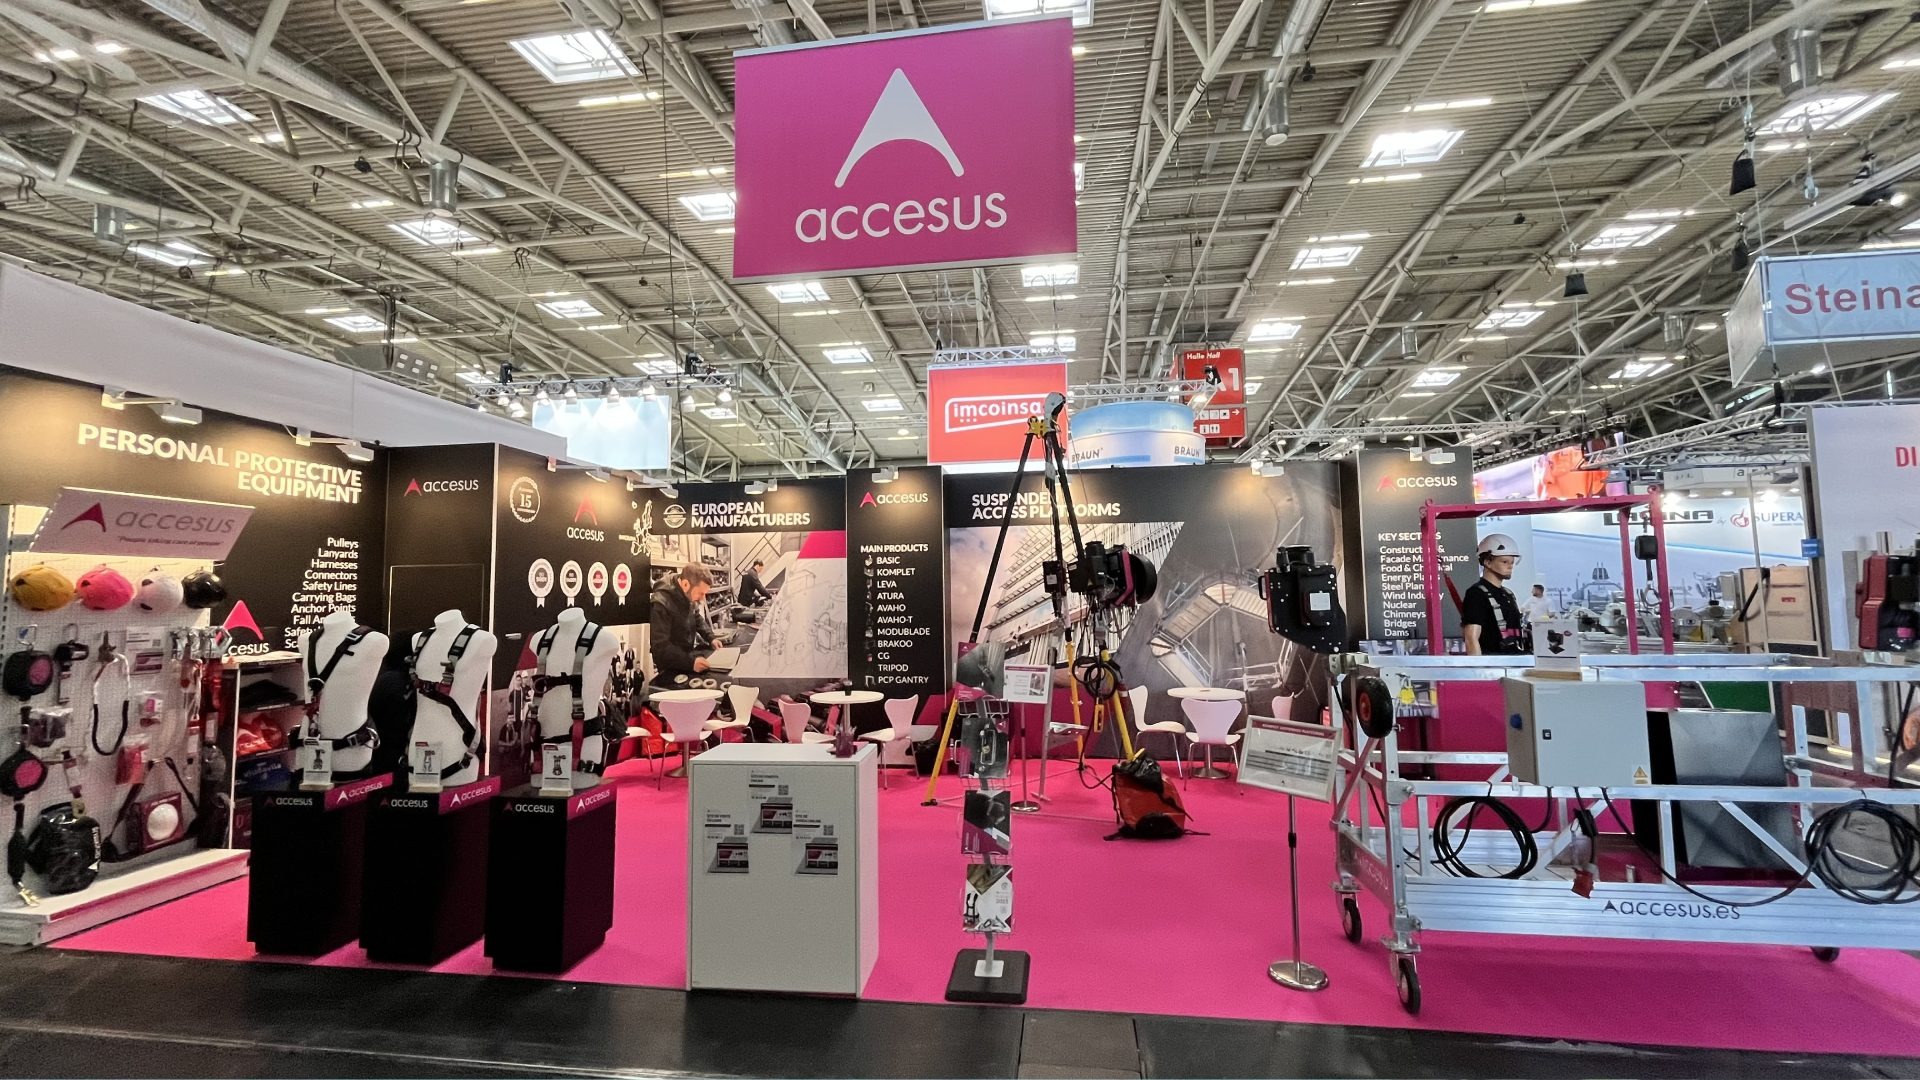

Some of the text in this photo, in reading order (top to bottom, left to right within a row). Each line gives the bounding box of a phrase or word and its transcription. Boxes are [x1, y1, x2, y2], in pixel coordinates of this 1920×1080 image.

[795, 192, 1007, 243] accesus
[953, 401, 1042, 418] imcoinsa
[77, 423, 362, 487] PERSONAL PROTECTIVE
[1071, 450, 1102, 463] BRAUN
[422, 479, 479, 493] accesus
[1397, 475, 1457, 488] accesus
[237, 471, 362, 504] EQUIPMENT
[520, 494, 532, 508] 15
[876, 492, 929, 505] accesus
[972, 492, 1052, 507] SUSPNDE
[691, 501, 765, 516] EUROPEAN
[115, 511, 235, 533] accesus
[690, 512, 811, 528] MANUFACTURERS
[567, 525, 605, 542] accesus
[1378, 532, 1442, 541] KEY SECTS
[327, 537, 359, 550] Pulleys
[860, 544, 929, 553] MAIN PRODUCTS
[318, 548, 358, 560] Lanyards
[1380, 545, 1445, 554] Construct &
[311, 559, 358, 570] Harnesses
[876, 556, 901, 565] BASIC
[1380, 555, 1411, 563] Facade
[877, 567, 916, 576] KOMPLET
[1381, 564, 1402, 572] Food
[1404, 564, 1411, 572] &
[304, 569, 357, 580] Connectors
[1381, 573, 1411, 584] Energy
[302, 580, 357, 592] Safety Lines
[877, 580, 897, 589] LEVA
[1382, 582, 1424, 591] Steel Plan
[292, 592, 357, 605] Carrying Bags
[877, 592, 905, 600] ATURA
[1382, 591, 1444, 601] Wind Induy
[291, 603, 356, 613] Anchor Points
[877, 604, 907, 612] AVAHO
[1383, 601, 1416, 609] Nuclear
[293, 615, 311, 624] Fall
[877, 615, 914, 624] AVAHO-T
[1383, 610, 1426, 620] Chimneys
[1384, 619, 1416, 630] Bridges
[877, 627, 931, 636] MODUBLADE
[1385, 629, 1409, 637] Dams
[222, 642, 270, 656] cesus
[877, 640, 913, 648] BRAKOO
[877, 652, 890, 660] CG
[878, 664, 909, 672] TRIPOD
[878, 676, 929, 684] PCP GANTRY
[349, 782, 383, 798] accesus
[461, 785, 492, 801] accesus
[275, 797, 313, 806] accesus
[391, 798, 428, 808] accesus
[585, 790, 611, 806] accesus
[516, 803, 555, 813] accesus
[1621, 899, 1742, 921] accesus.es
